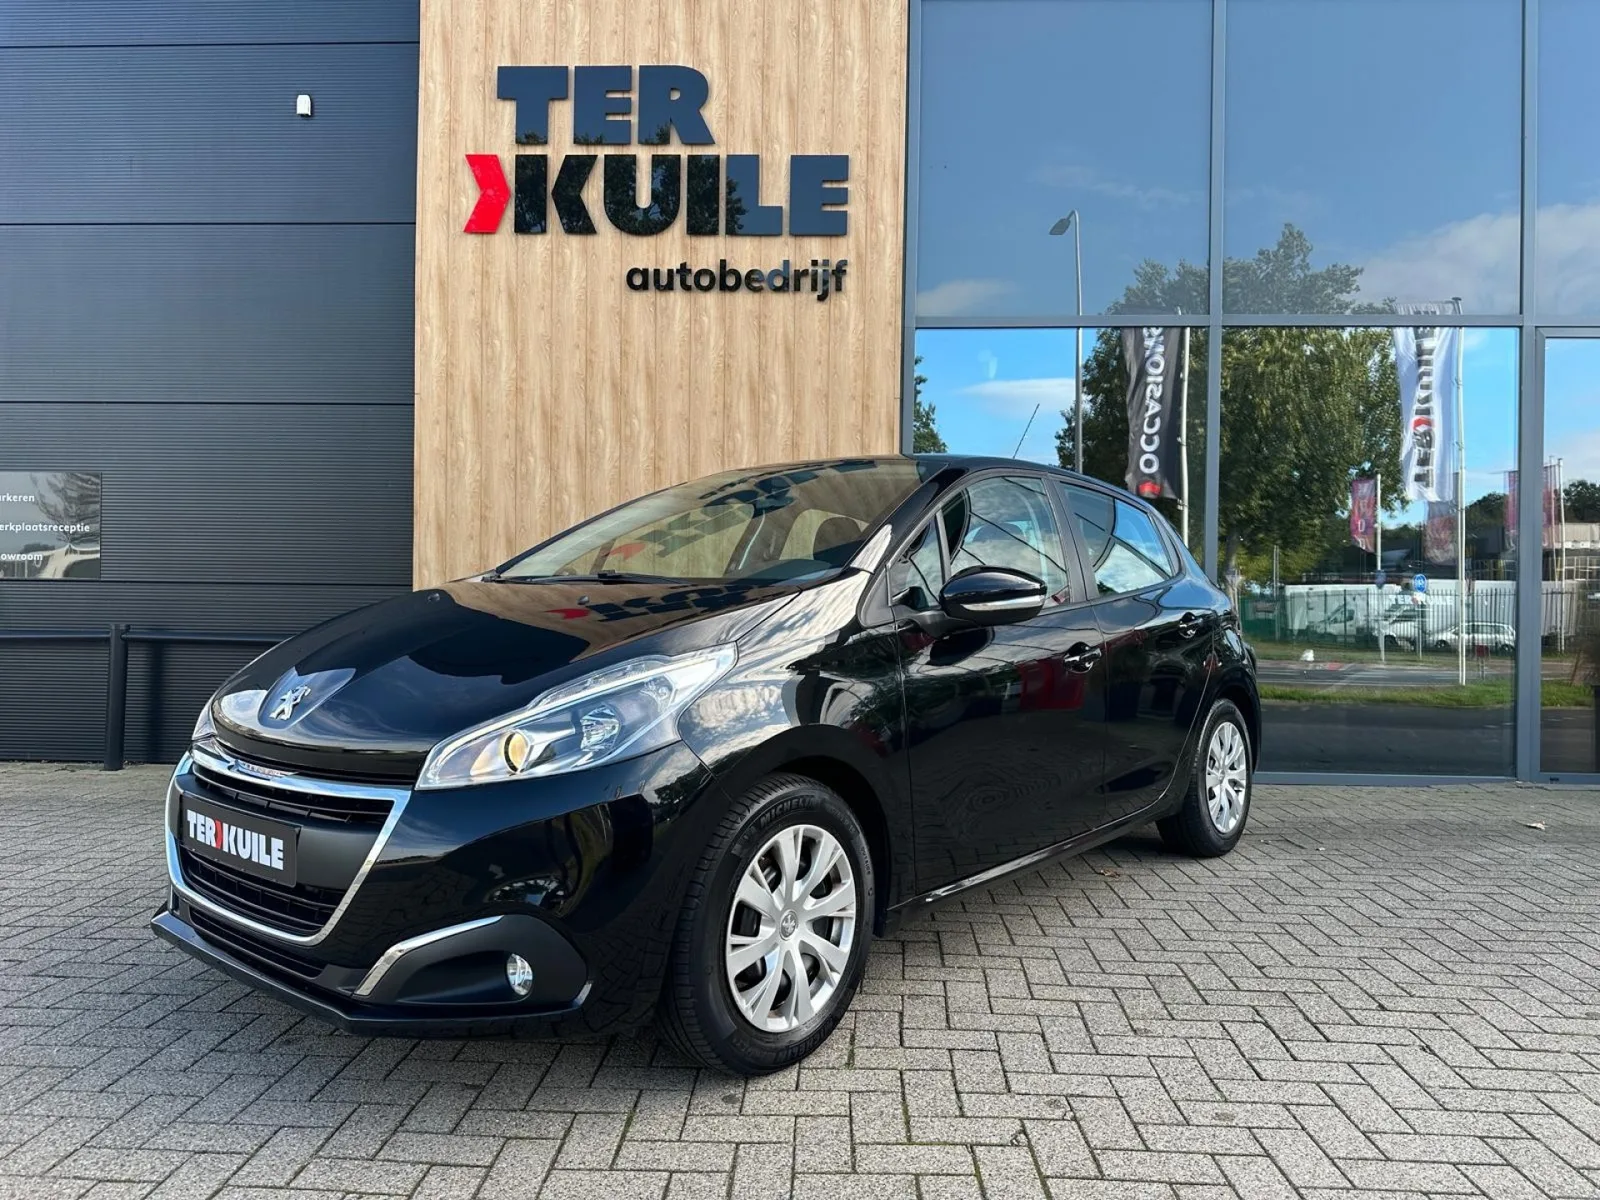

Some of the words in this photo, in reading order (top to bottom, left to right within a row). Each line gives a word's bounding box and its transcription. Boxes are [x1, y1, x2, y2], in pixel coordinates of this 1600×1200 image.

[497, 66, 715, 145] TER
[514, 154, 849, 236] KUILE
[626, 259, 848, 302] autobedrijf
[186, 809, 217, 848] TER
[222, 823, 284, 871] KUILE
